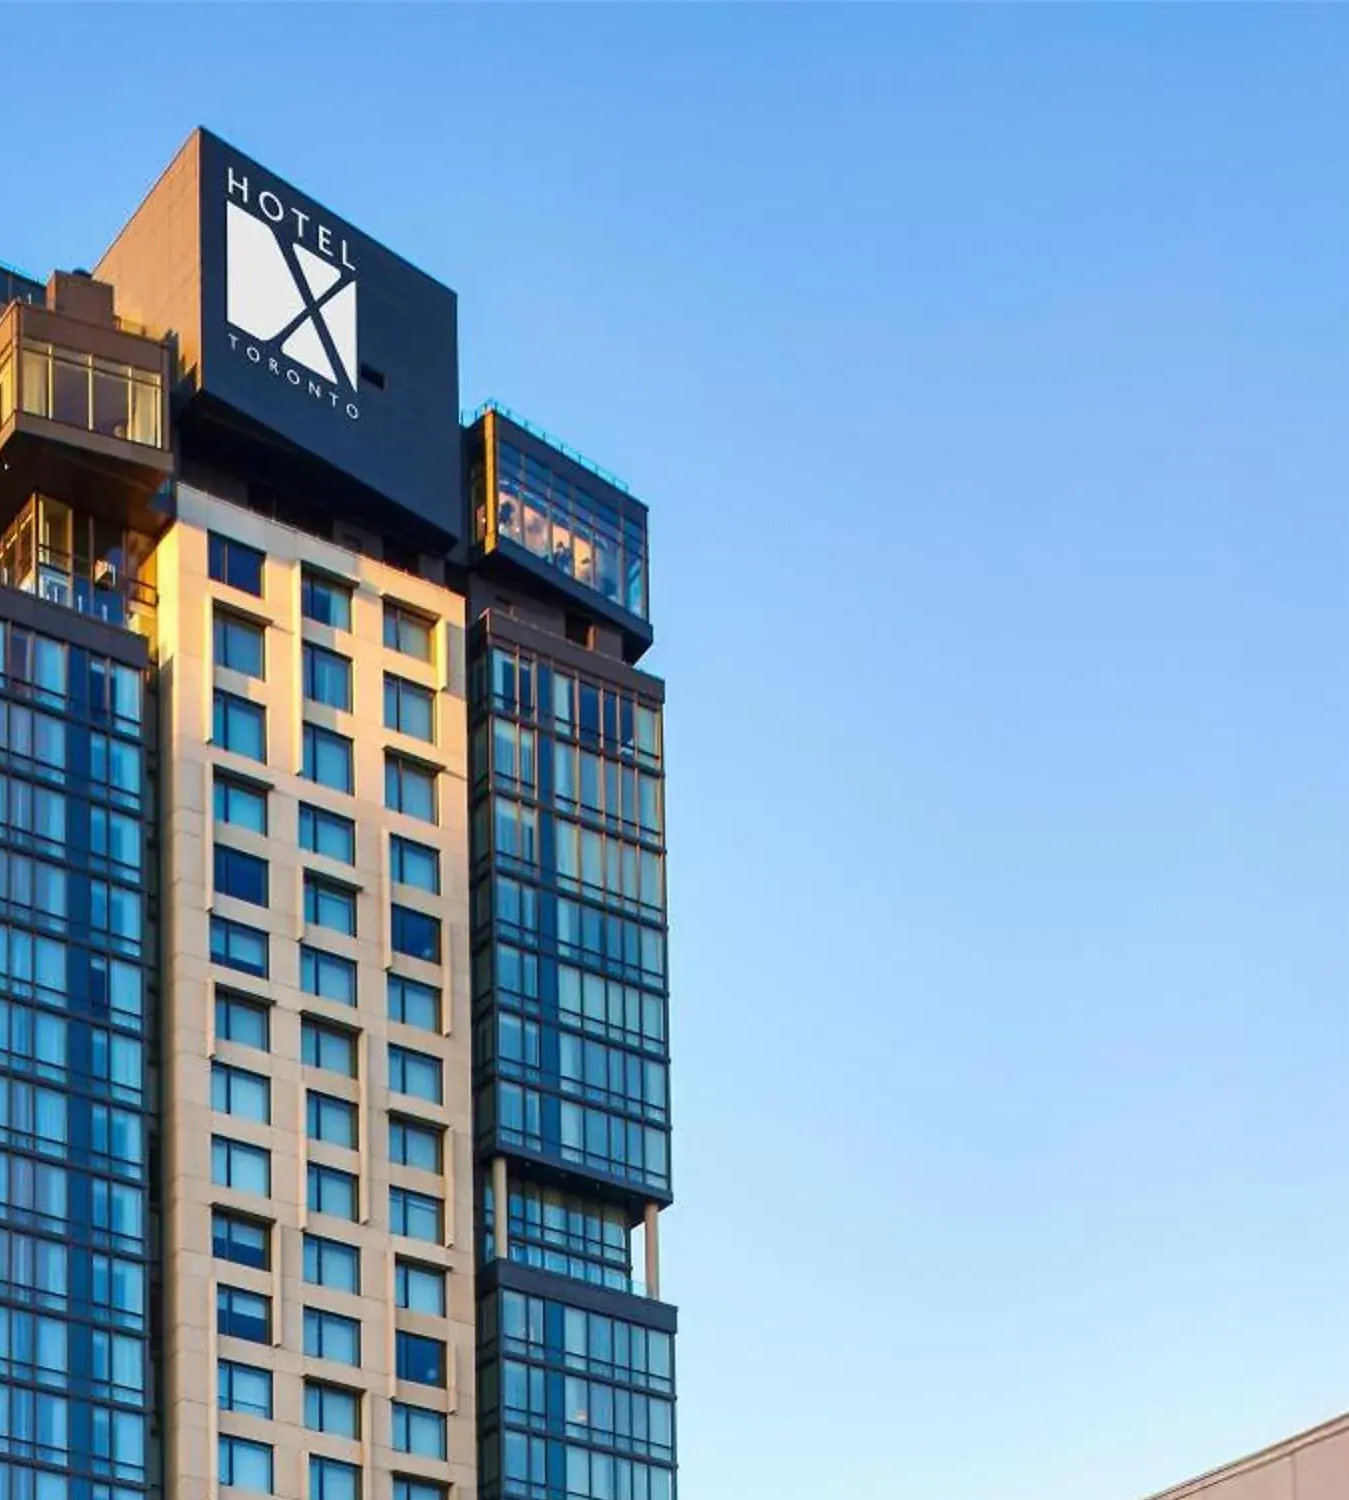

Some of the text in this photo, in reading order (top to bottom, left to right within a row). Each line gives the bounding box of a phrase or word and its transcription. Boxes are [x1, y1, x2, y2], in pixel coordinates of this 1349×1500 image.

[228, 167, 356, 271] HOTEL
[231, 202, 357, 392] X
[228, 333, 359, 419] TORONTO
